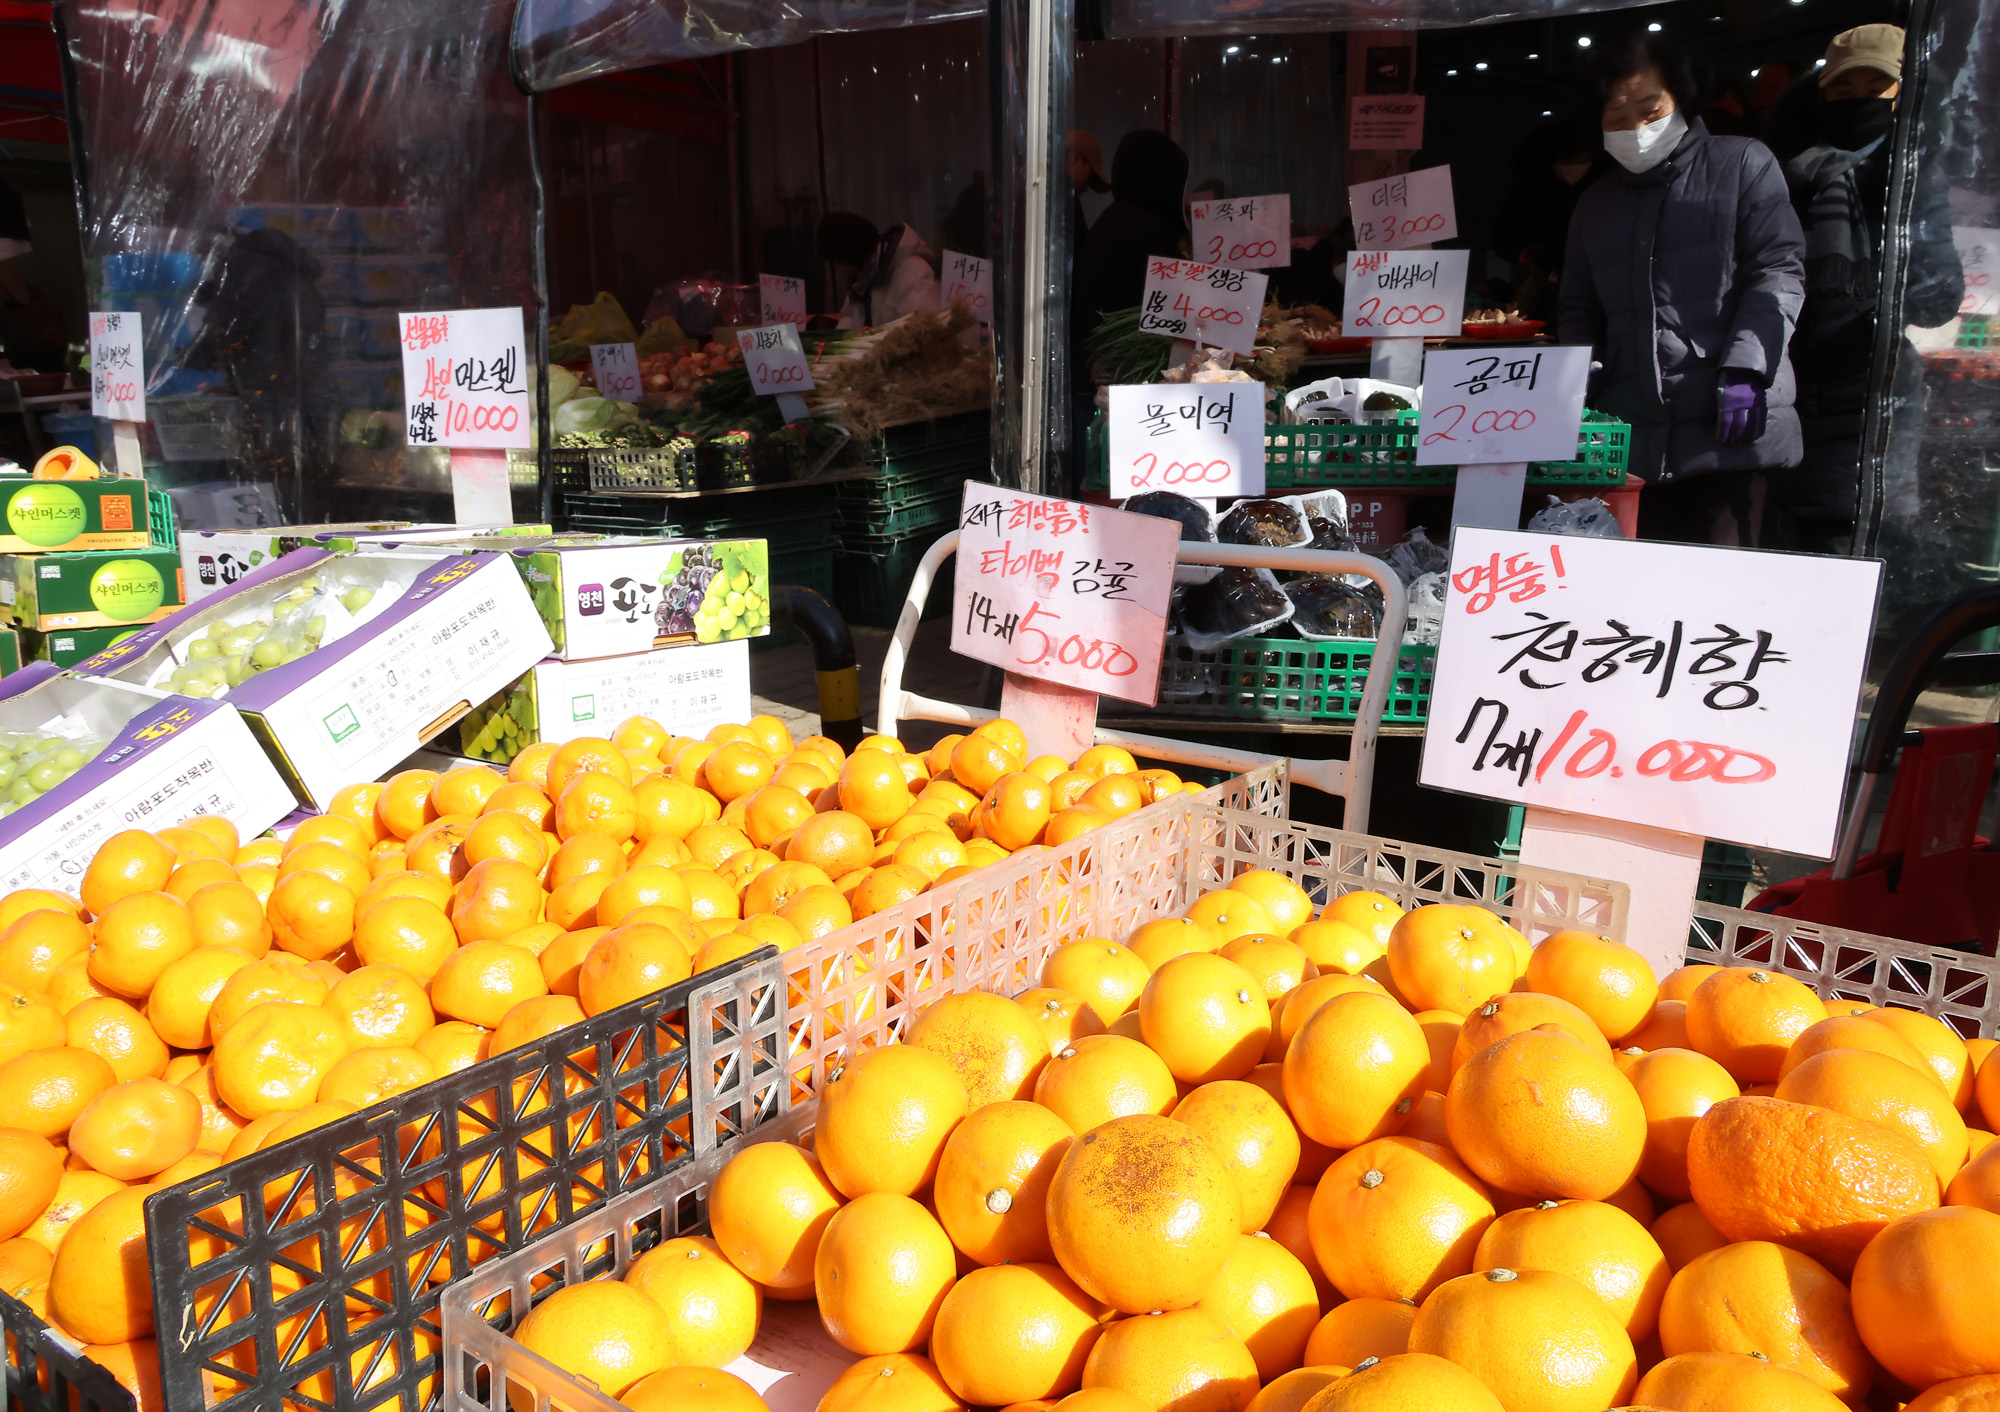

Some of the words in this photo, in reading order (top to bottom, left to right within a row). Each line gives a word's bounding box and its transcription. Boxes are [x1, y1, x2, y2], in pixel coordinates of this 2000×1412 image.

[1372, 176, 1408, 208] 더덕
[1214, 200, 1258, 222] 쪽파
[1382, 213, 1446, 243] 3.000
[1208, 235, 1277, 264] 3.000
[953, 257, 985, 282] 대파
[1207, 269, 1248, 292] 생강
[1141, 313, 1187, 334] (500g)
[1355, 297, 1445, 327] 2.000
[401, 314, 449, 351] 선물용!
[756, 329, 783, 350] 시금치
[602, 371, 636, 394] 1500
[1454, 353, 1542, 395] 곰피
[411, 402, 439, 424] 1상자
[445, 400, 518, 437] 10.000
[1138, 392, 1235, 436] 물미역
[1423, 404, 1537, 446] 2.000
[1130, 452, 1231, 488] 2.000
[12, 507, 81, 521] 샤인머스켓
[961, 500, 1010, 537] 제주
[1008, 498, 1090, 537] 최상품!
[200, 562, 215, 577] 영천
[1072, 559, 1139, 603] 감귤
[1452, 544, 1568, 615] 명품!
[95, 581, 160, 596] 샤인머스켓
[579, 591, 603, 608] 영천
[609, 577, 657, 623] 포도
[431, 597, 495, 646] 아람포도작목반
[1016, 601, 1139, 677] 5.000
[669, 667, 723, 685] 아람포도작목반
[1455, 696, 1543, 788] 7개
[1535, 710, 1777, 785] 10.000
[124, 758, 214, 822] 아람포도작목반
